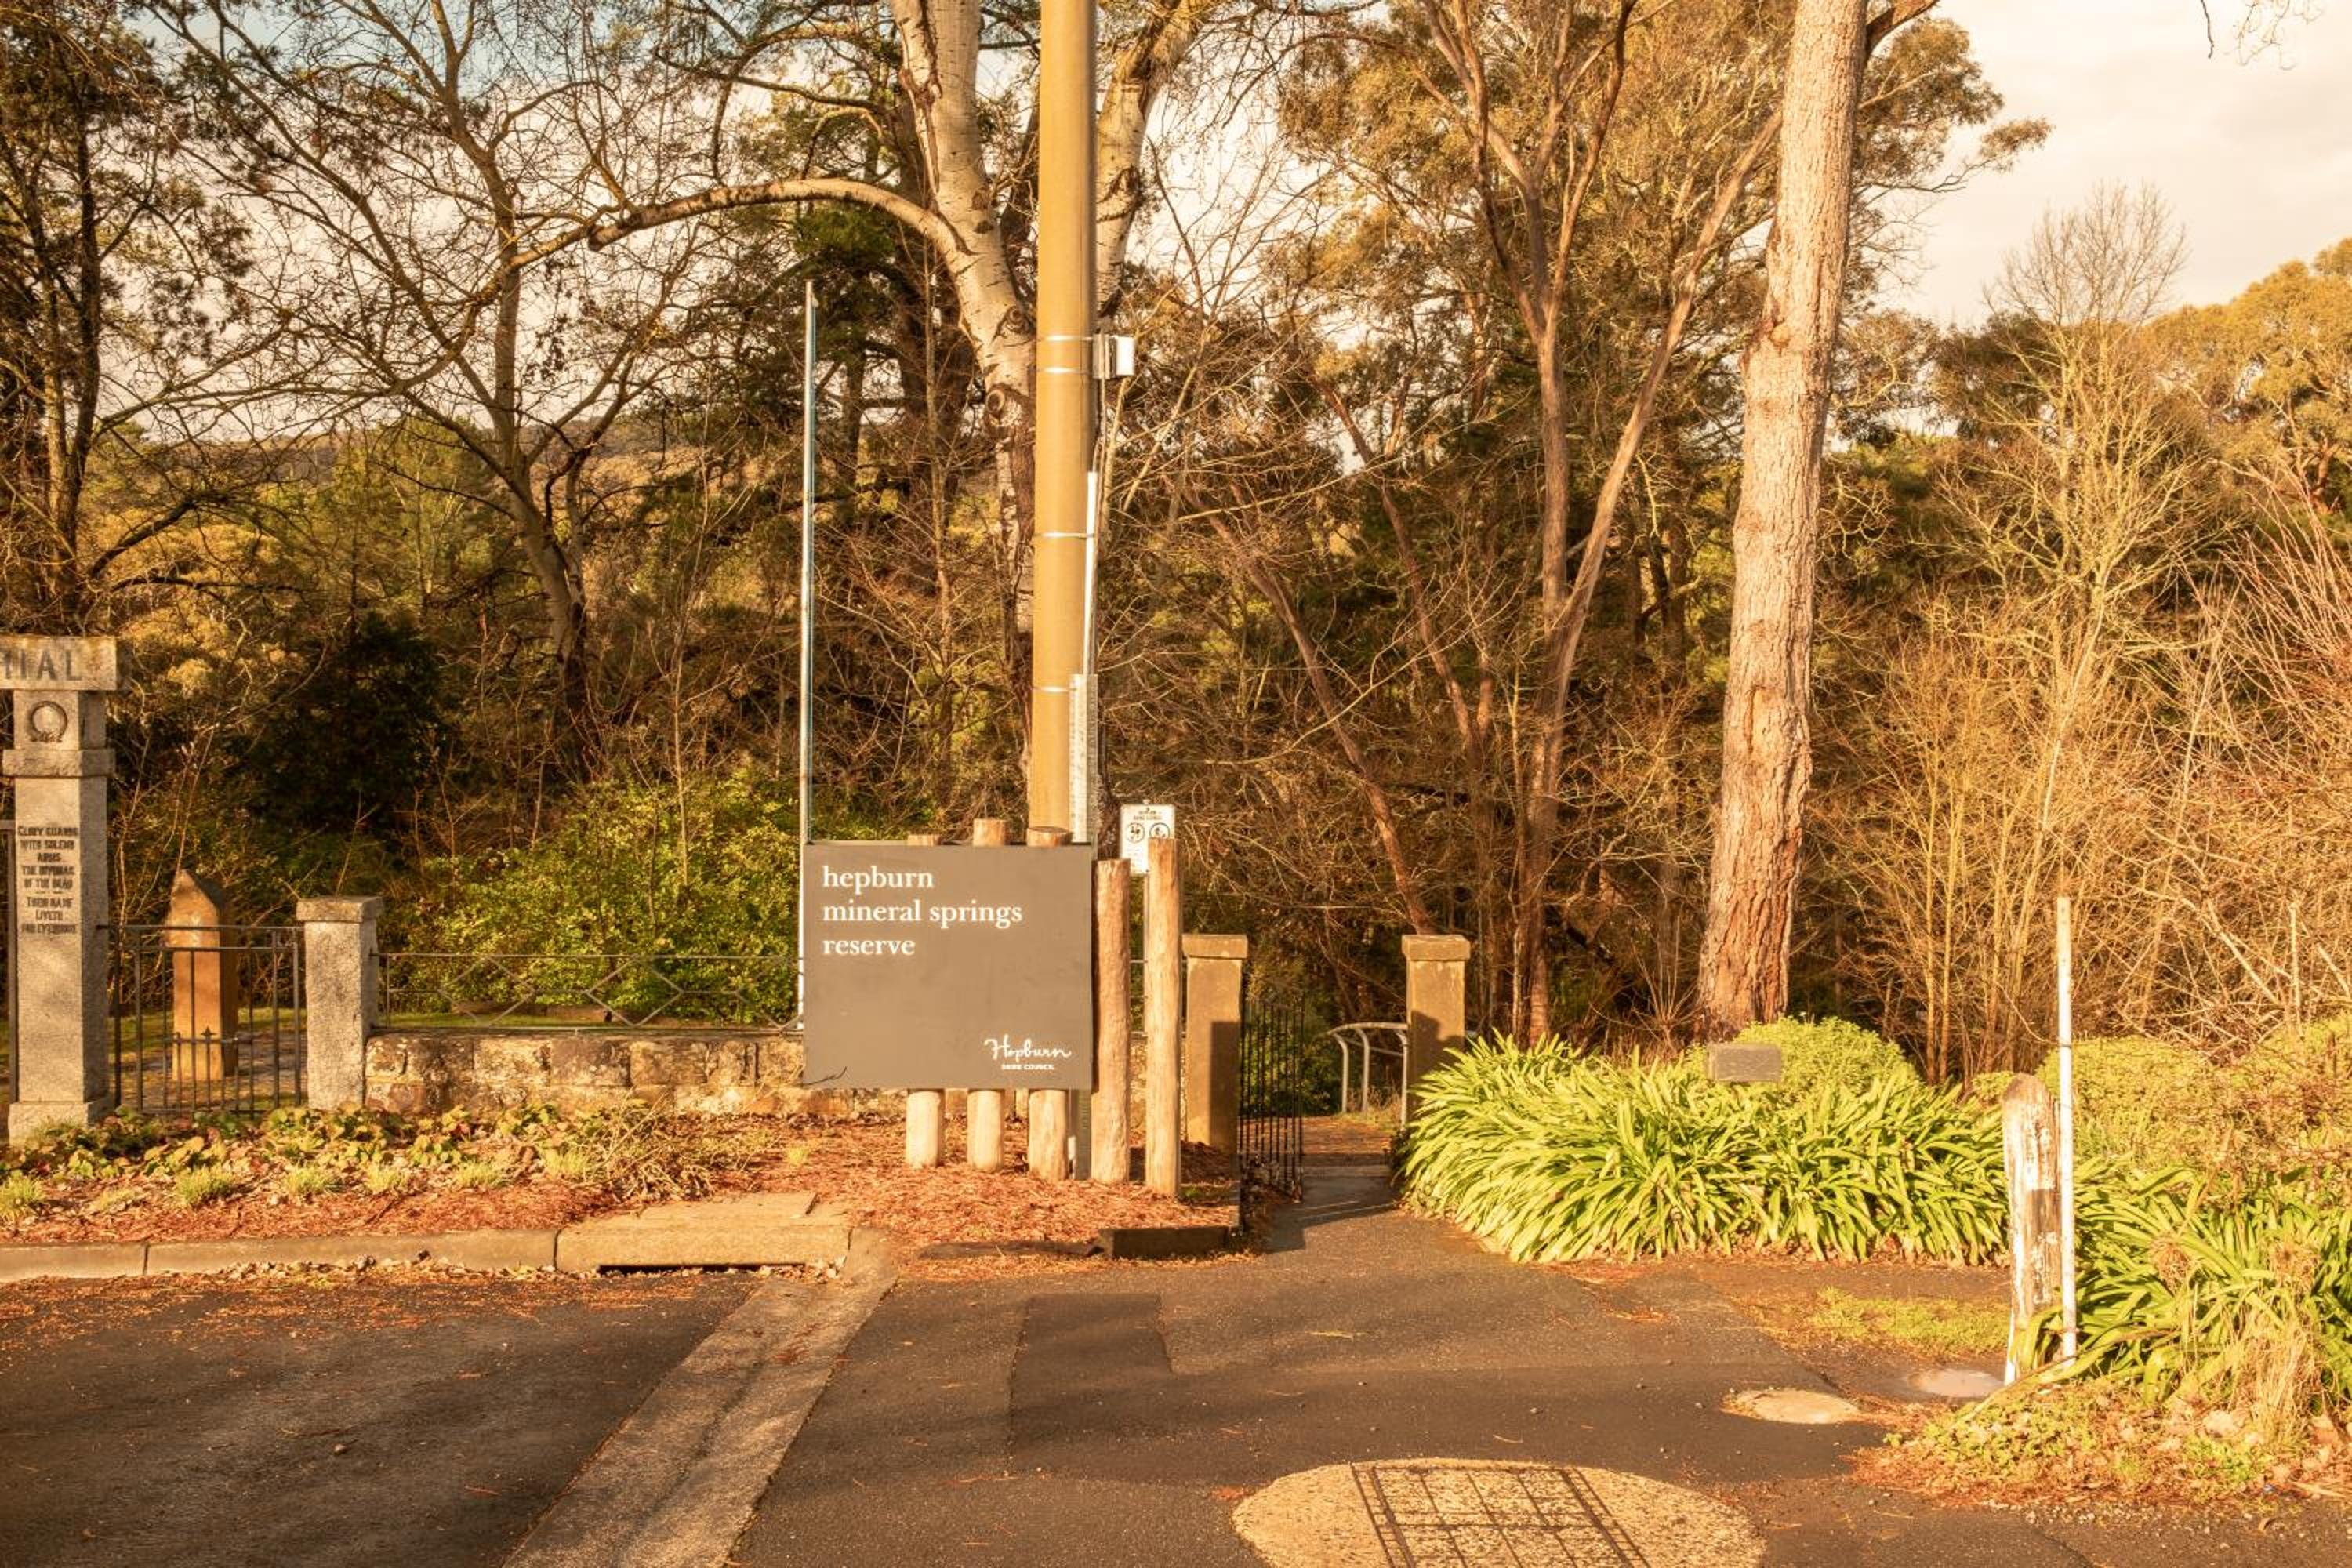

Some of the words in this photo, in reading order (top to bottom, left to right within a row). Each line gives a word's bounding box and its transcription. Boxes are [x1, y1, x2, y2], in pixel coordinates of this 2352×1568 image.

[822, 865, 935, 895] hepburn
[822, 899, 921, 922] mineral
[929, 899, 1023, 929] springs
[822, 939, 916, 956] reserve
[984, 1033, 1072, 1062] Hepburn
